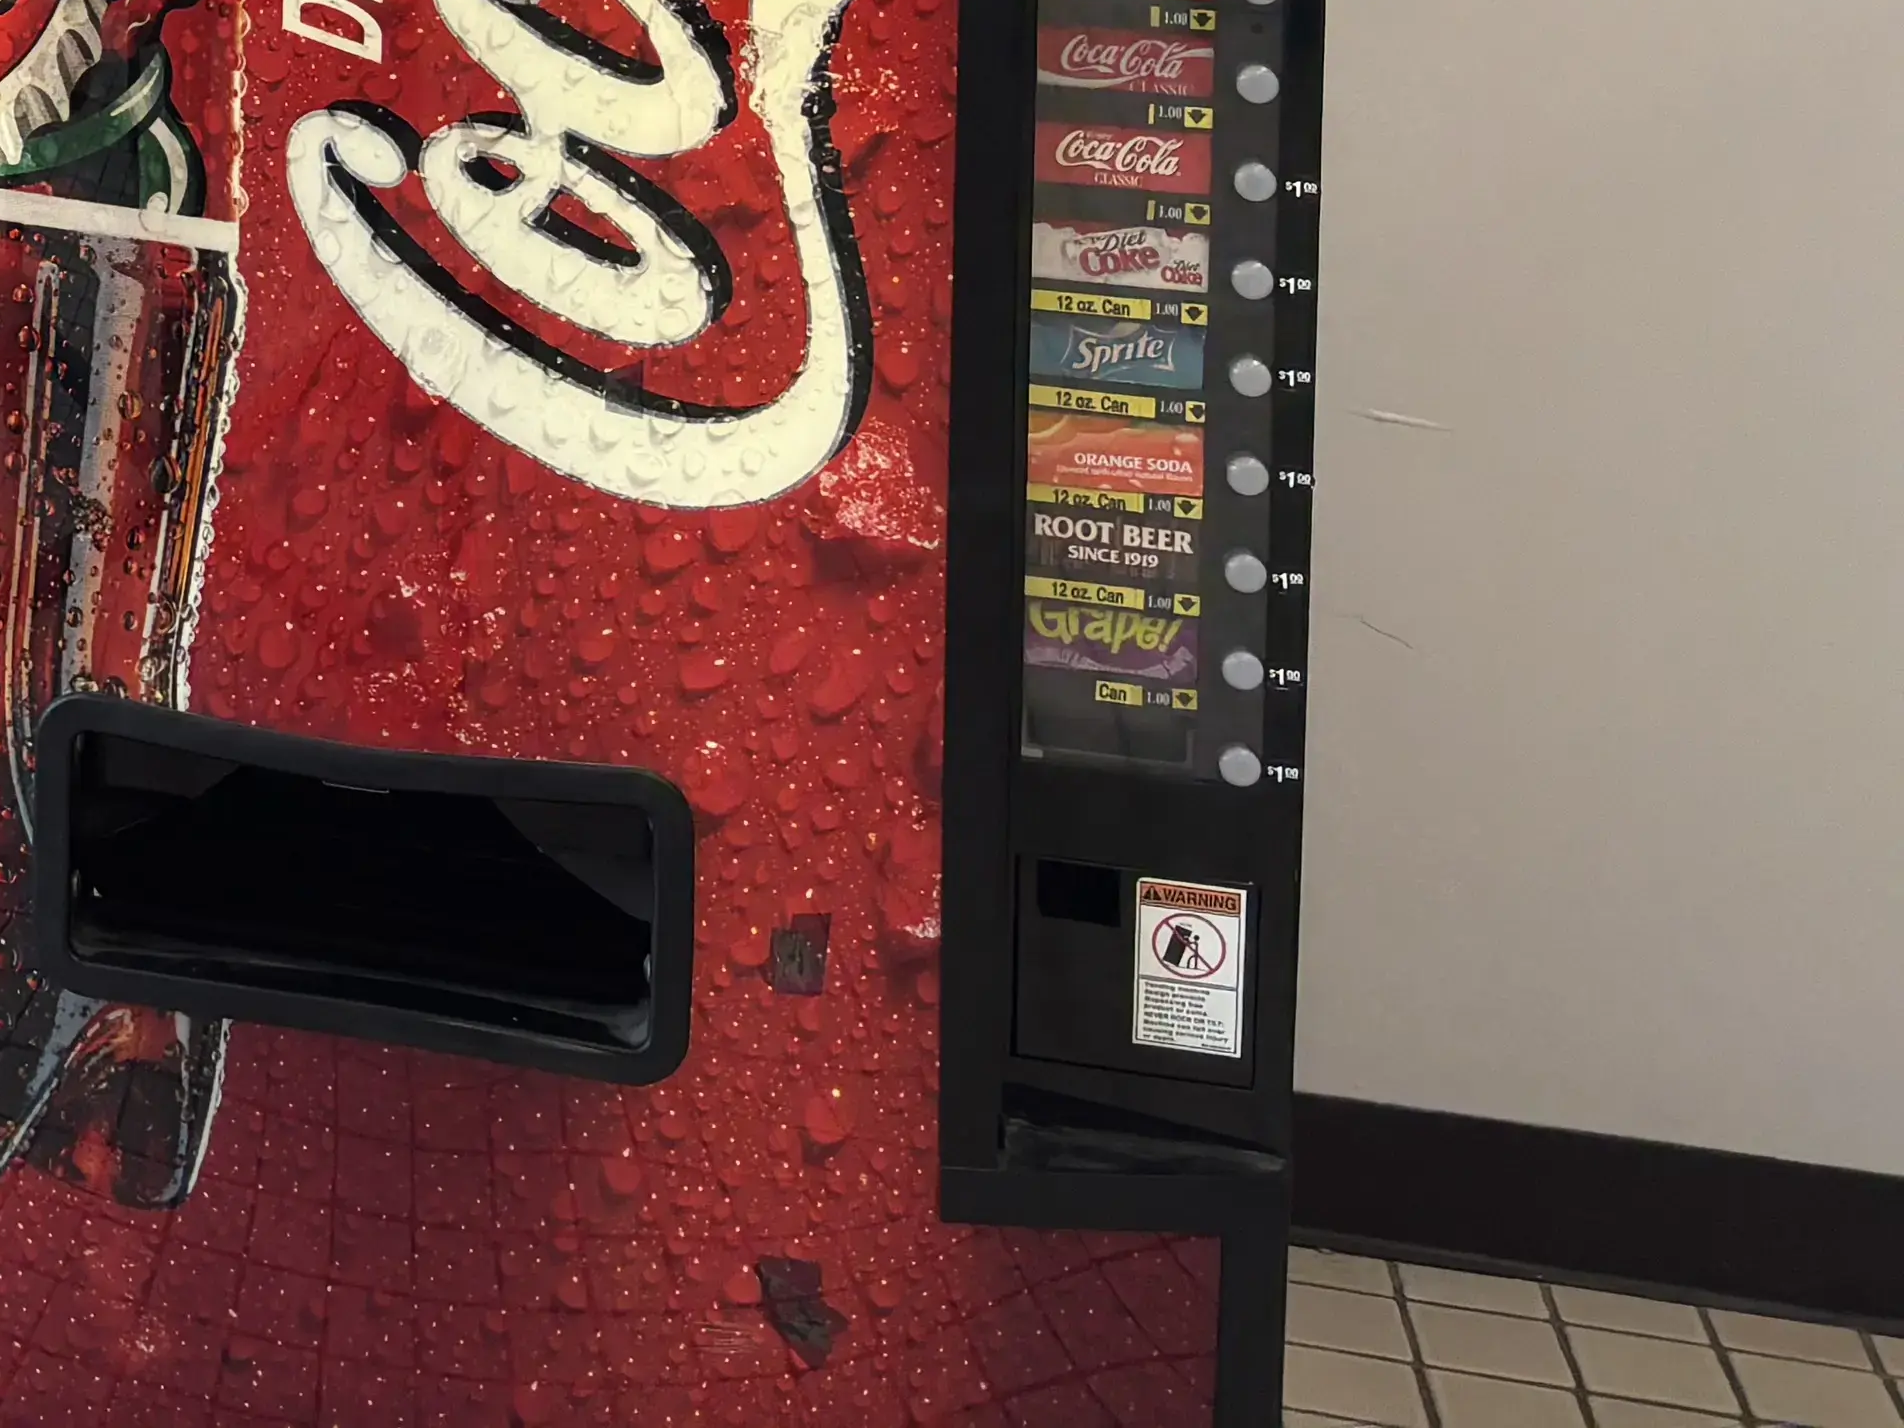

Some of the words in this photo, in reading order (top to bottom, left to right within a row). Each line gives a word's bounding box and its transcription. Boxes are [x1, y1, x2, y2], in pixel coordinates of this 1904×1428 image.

[1164, 11, 1188, 24] 1.00
[1060, 33, 1190, 80] Coca-Cola
[1158, 105, 1182, 119] 1.00
[1055, 130, 1184, 177] Coca-Cola
[1094, 172, 1143, 188] CLASSIC
[1158, 205, 1182, 219] 1.00
[1097, 229, 1147, 252] Diet
[1079, 246, 1161, 276] Coke
[1057, 295, 1073, 310] 12
[1077, 299, 1097, 313] oz.
[1102, 299, 1130, 317] Can
[1155, 302, 1179, 316] 1.00
[1072, 329, 1165, 373] Sprite
[1056, 391, 1072, 406] 12
[1075, 396, 1096, 409] oz.
[1101, 395, 1129, 413] Can
[1074, 452, 1143, 471] ORANGE
[1147, 457, 1193, 474] SODA
[1053, 489, 1069, 504] 12
[1073, 493, 1093, 505] oz.
[1097, 493, 1126, 511] Can
[1034, 513, 1114, 544] ROOT
[1122, 524, 1194, 554] BEER
[1067, 545, 1120, 563] SINCE
[1124, 552, 1159, 567] 1919
[1052, 582, 1068, 597] 12
[1071, 586, 1092, 600] oz.
[1096, 586, 1124, 604] Can
[1148, 595, 1171, 609] 1.00
[1099, 684, 1126, 701] Can
[1147, 692, 1170, 705] 1.00
[1162, 887, 1238, 912] WARNING
